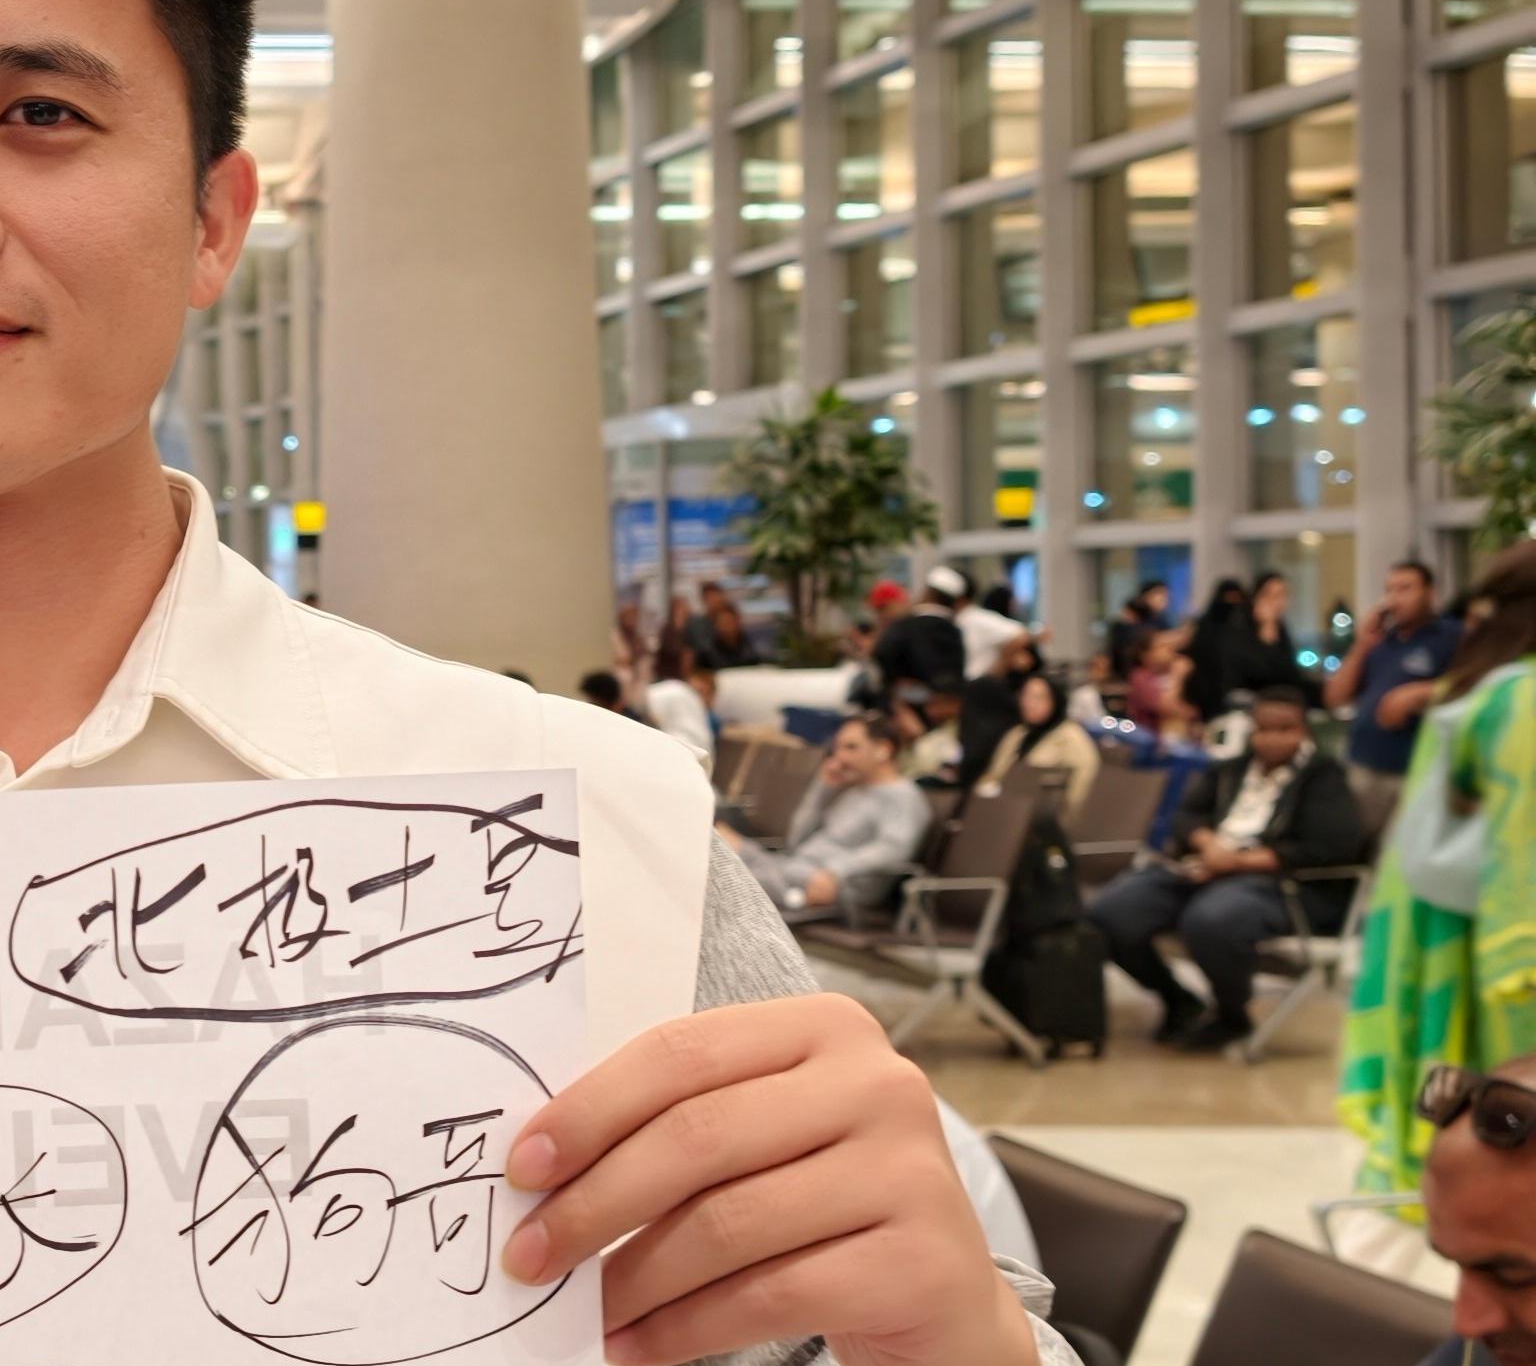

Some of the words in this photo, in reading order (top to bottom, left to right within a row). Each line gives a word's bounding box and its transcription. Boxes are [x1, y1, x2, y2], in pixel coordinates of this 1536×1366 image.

[59, 794, 584, 983] 北极土豆
[178, 1108, 506, 1305] 狗哥
